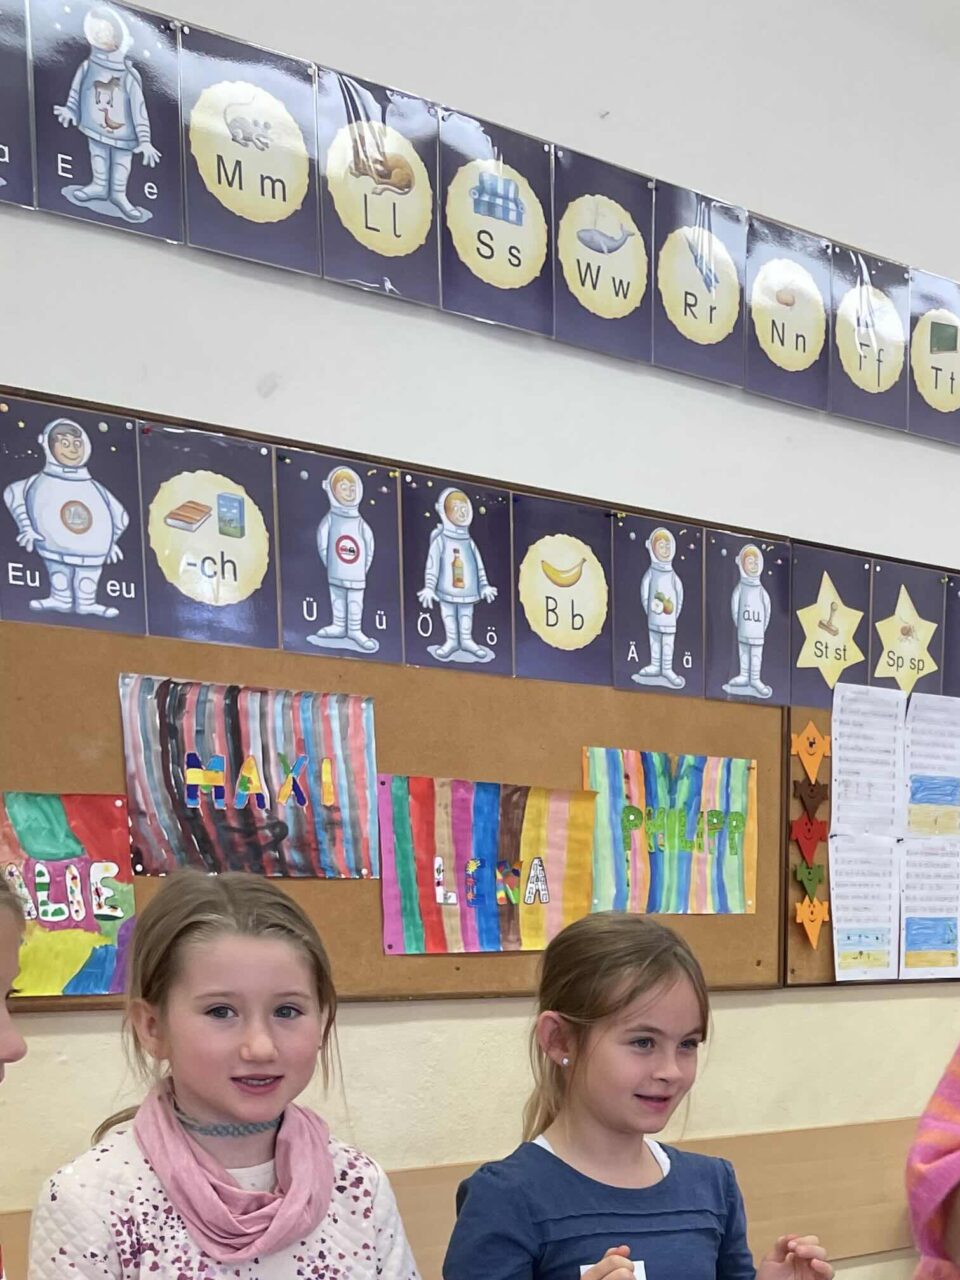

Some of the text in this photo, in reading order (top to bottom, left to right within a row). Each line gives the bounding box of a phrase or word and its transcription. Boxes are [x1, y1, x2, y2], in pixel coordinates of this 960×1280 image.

[57, 153, 158, 200] E e
[8, 562, 136, 598] Eu eu
[187, 551, 238, 582] -ch
[303, 597, 387, 630] Ü ü
[417, 611, 498, 645] Ö ö
[627, 641, 639, 662] Ä
[814, 640, 848, 661] St st
[886, 650, 925, 674] Sp sp
